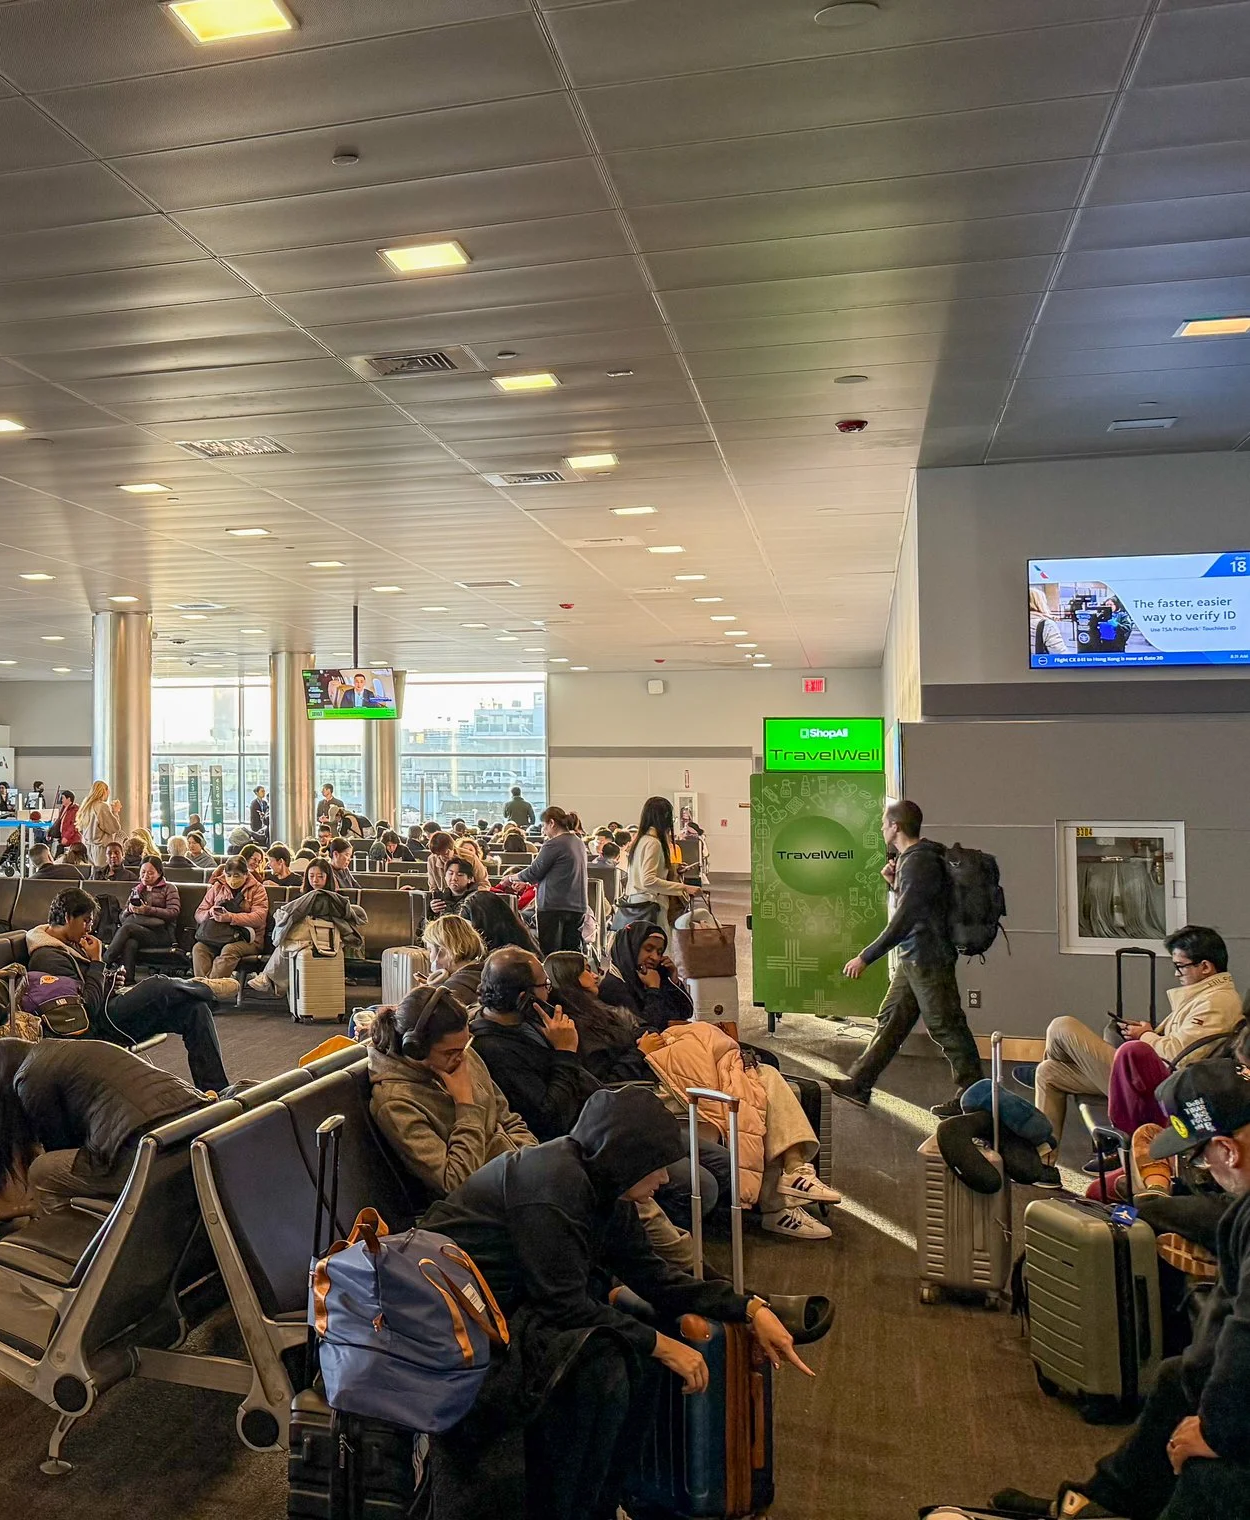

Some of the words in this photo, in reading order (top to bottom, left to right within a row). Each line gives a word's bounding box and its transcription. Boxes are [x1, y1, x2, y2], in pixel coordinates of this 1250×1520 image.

[1230, 561, 1247, 573] 18
[1133, 599, 1154, 608] The
[1196, 596, 1233, 607] easier
[1142, 614, 1167, 624] way
[1170, 611, 1182, 621] to
[1185, 610, 1220, 623] verify
[1223, 610, 1237, 620] ID
[809, 728, 848, 739] ShopAll
[769, 748, 880, 761] TravelWell
[776, 850, 854, 860] TravelWell
